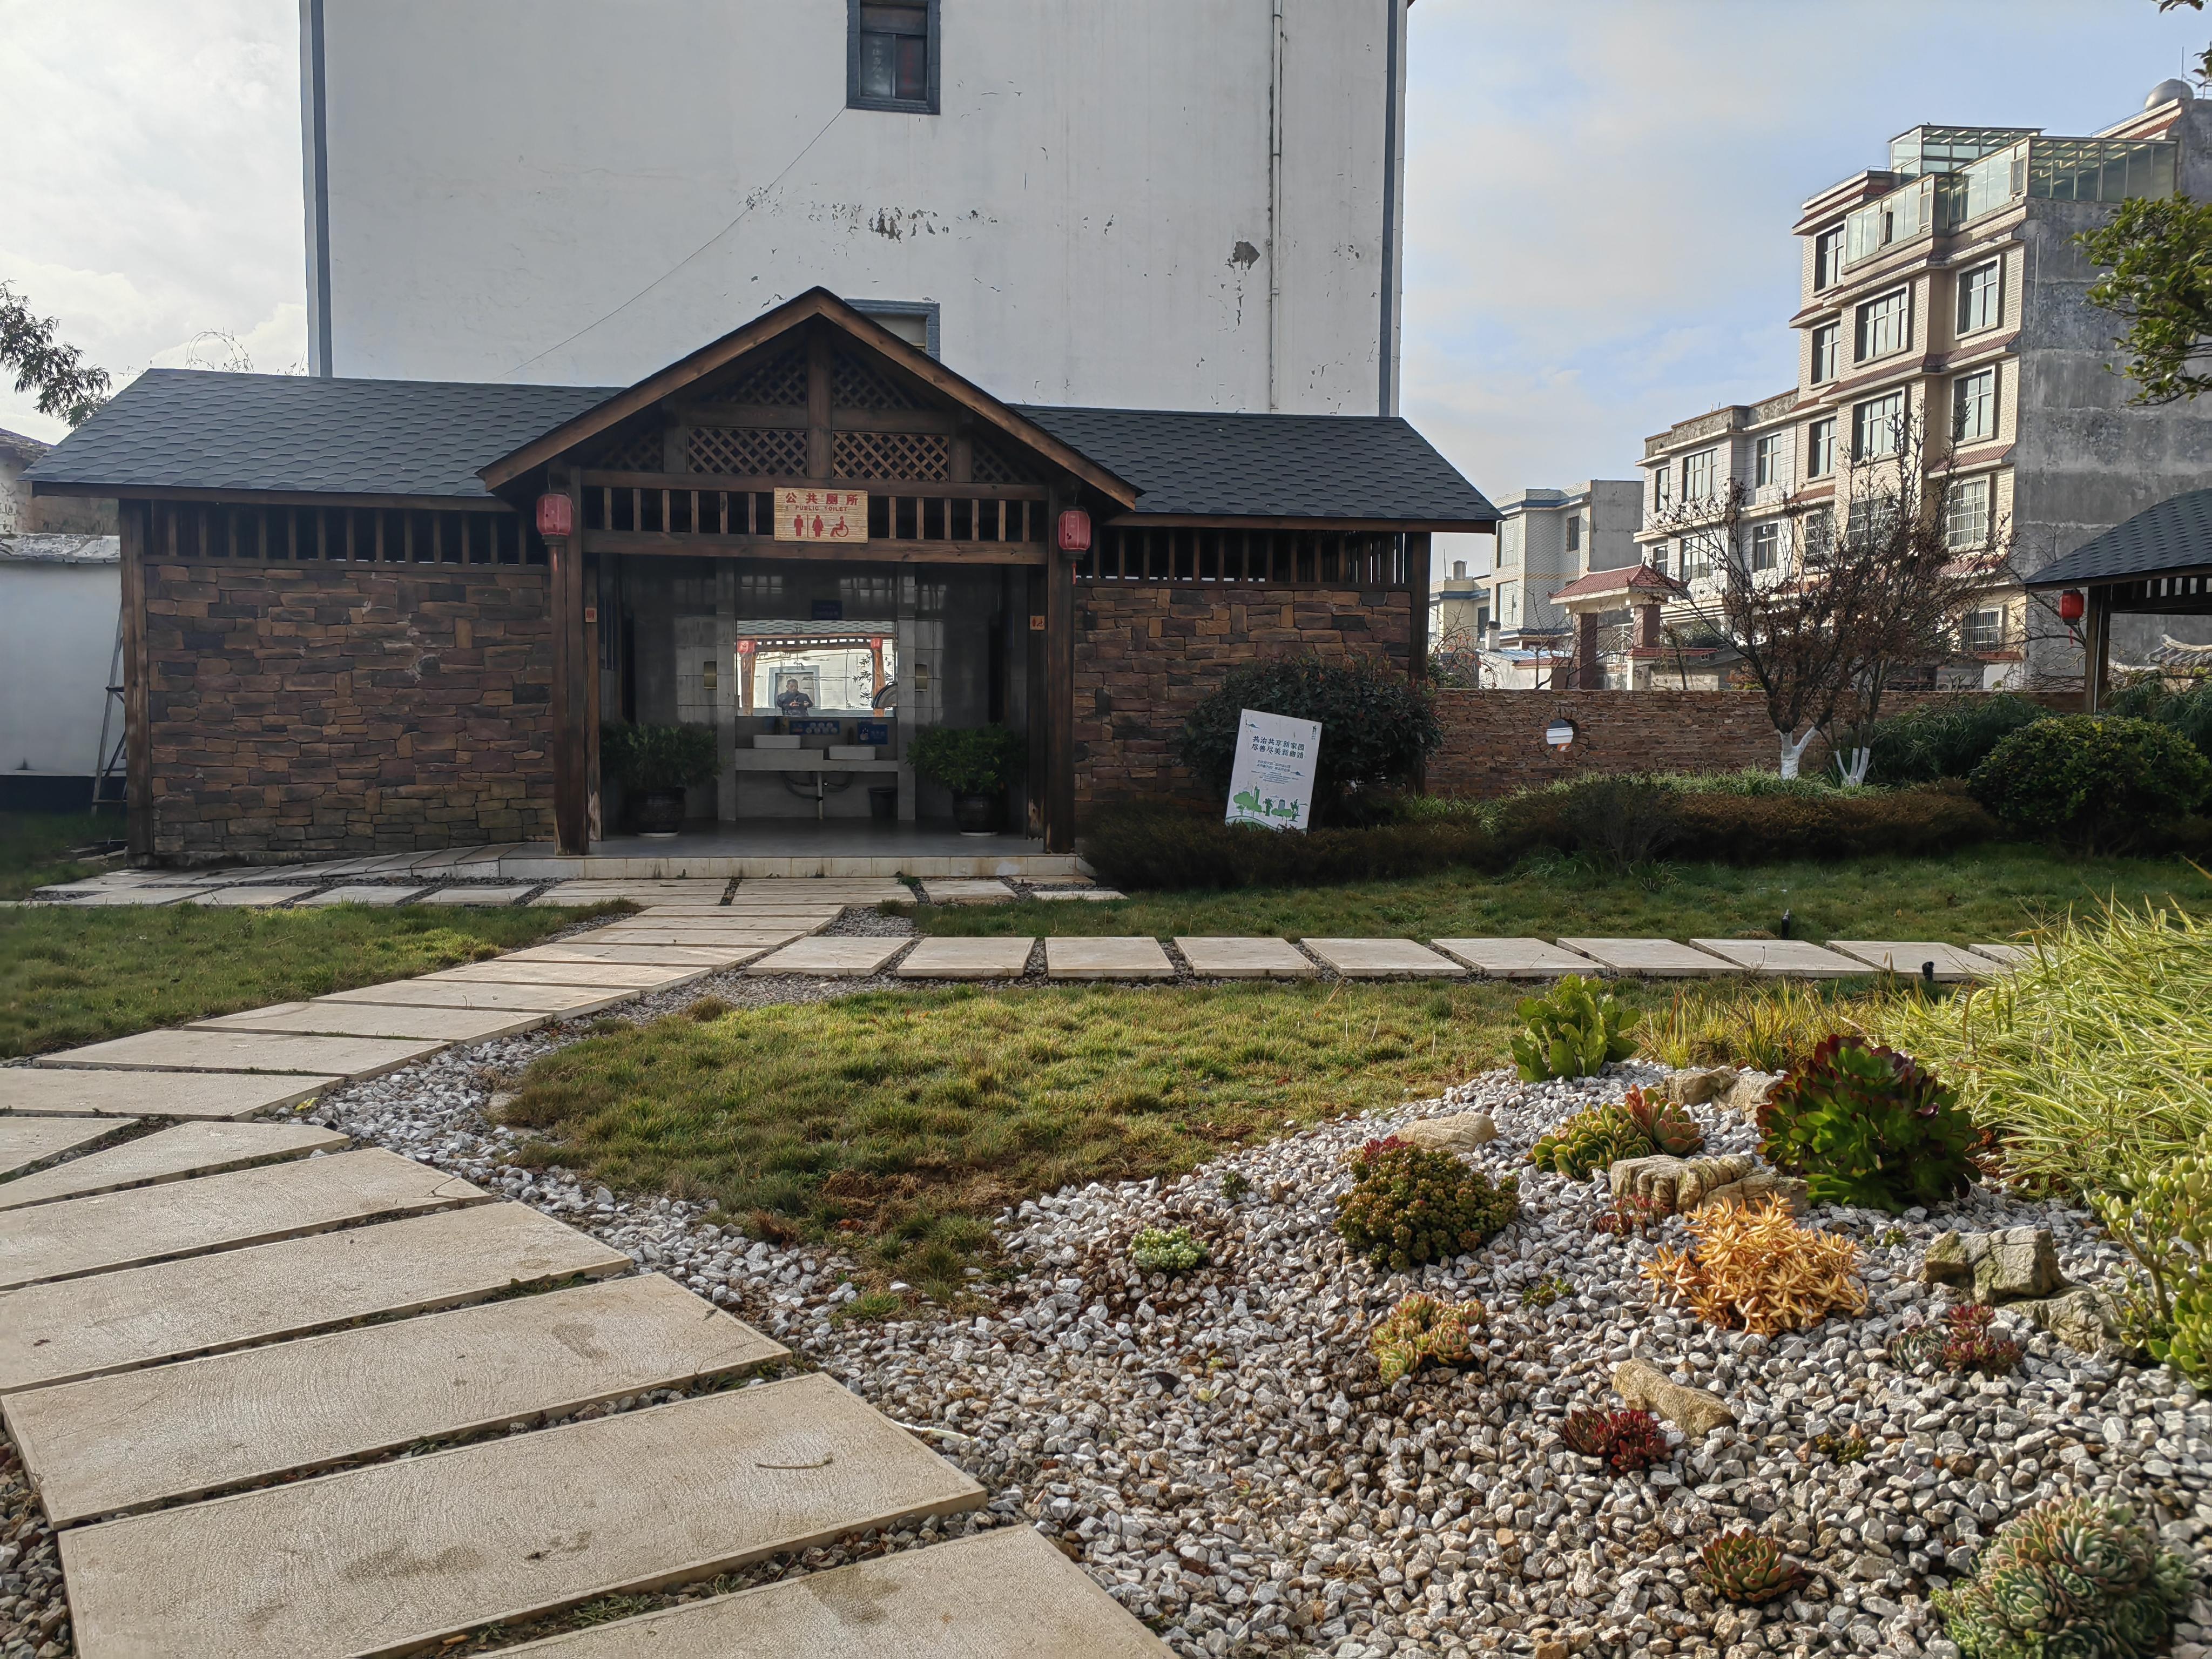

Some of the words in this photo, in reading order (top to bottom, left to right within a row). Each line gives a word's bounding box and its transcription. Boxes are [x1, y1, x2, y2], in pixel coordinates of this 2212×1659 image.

[785, 492, 859, 505] 公共厕所
[1252, 736, 1305, 751] 共治共享新家园
